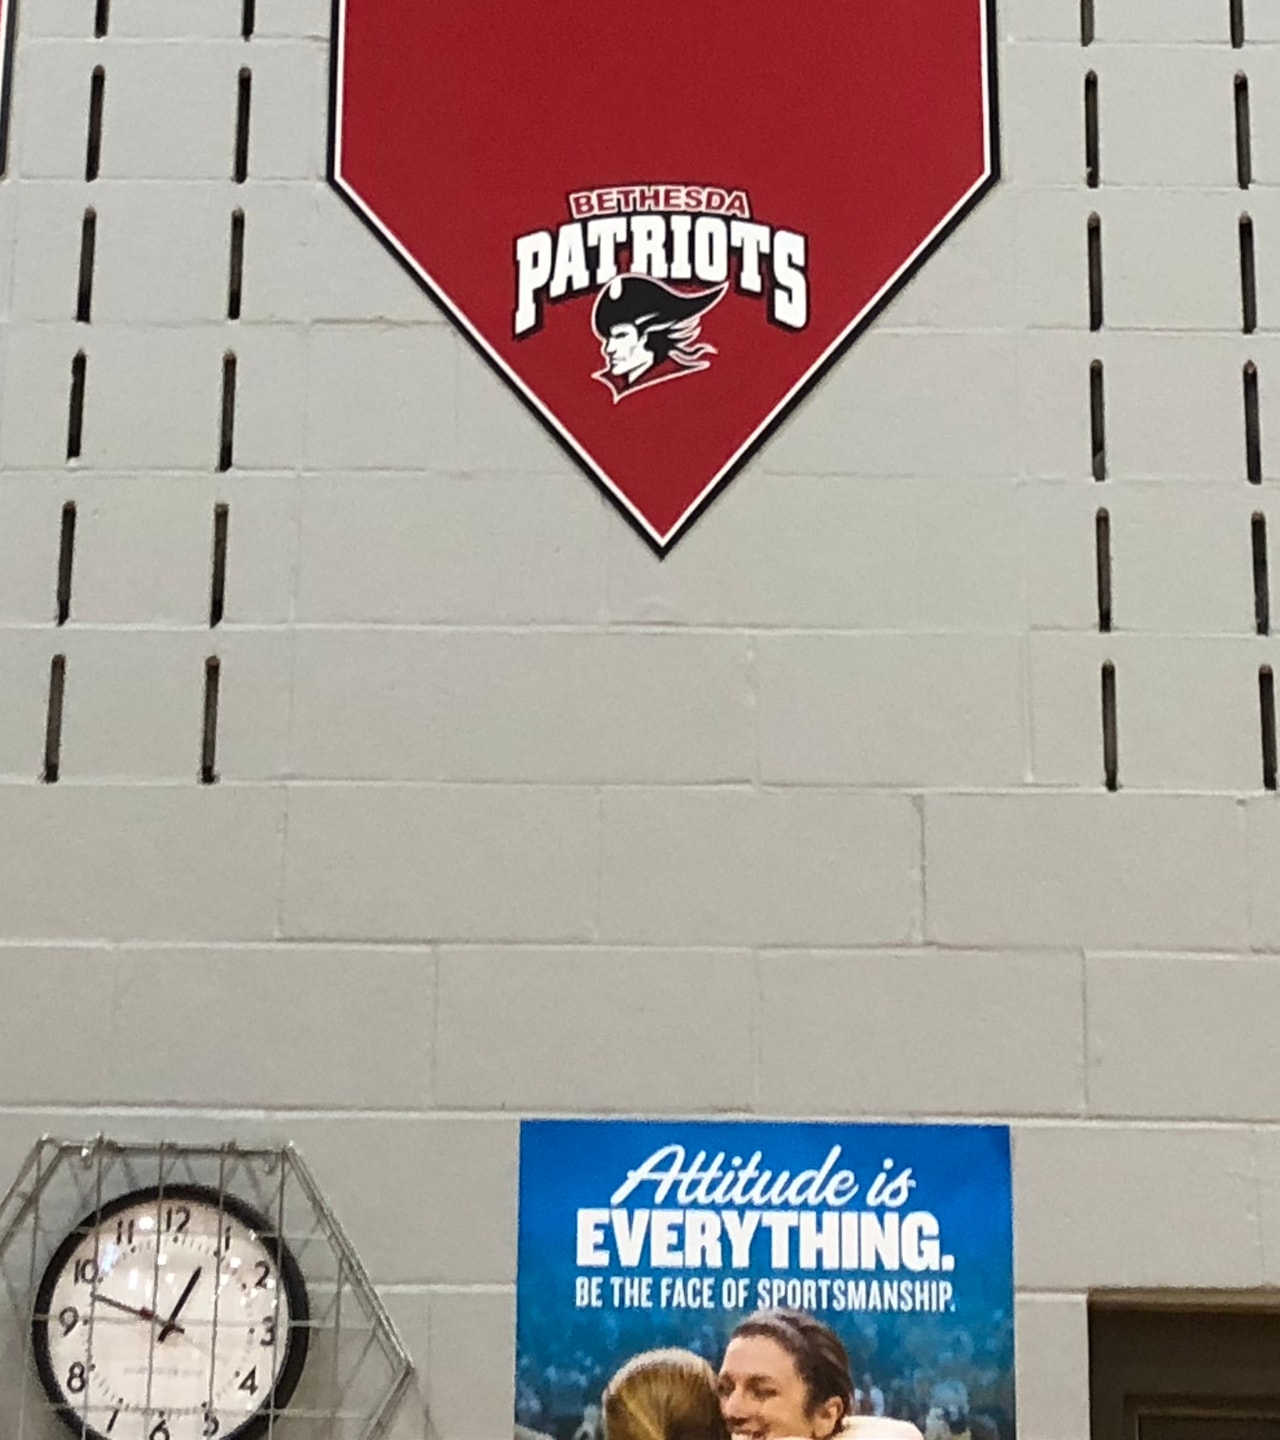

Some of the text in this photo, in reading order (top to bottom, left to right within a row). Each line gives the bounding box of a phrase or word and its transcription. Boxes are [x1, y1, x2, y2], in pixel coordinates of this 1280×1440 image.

[569, 185, 749, 219] BETHESDA
[514, 215, 808, 334] PATRIOTS
[611, 1143, 915, 1207] Attitude is
[117, 1219, 134, 1245] 11
[166, 1207, 191, 1232] 12
[224, 1226, 231, 1250] 1
[576, 1209, 955, 1271] EVERYTHING.
[73, 1259, 97, 1285] 10
[255, 1261, 270, 1289] 2
[575, 1276, 955, 1313] BE THE FACE OF SPORTSMANSHIP.
[59, 1307, 79, 1336] 9
[260, 1316, 275, 1346] 3
[67, 1362, 85, 1393] 8
[239, 1366, 258, 1395] 4
[150, 1420, 170, 1440] 6
